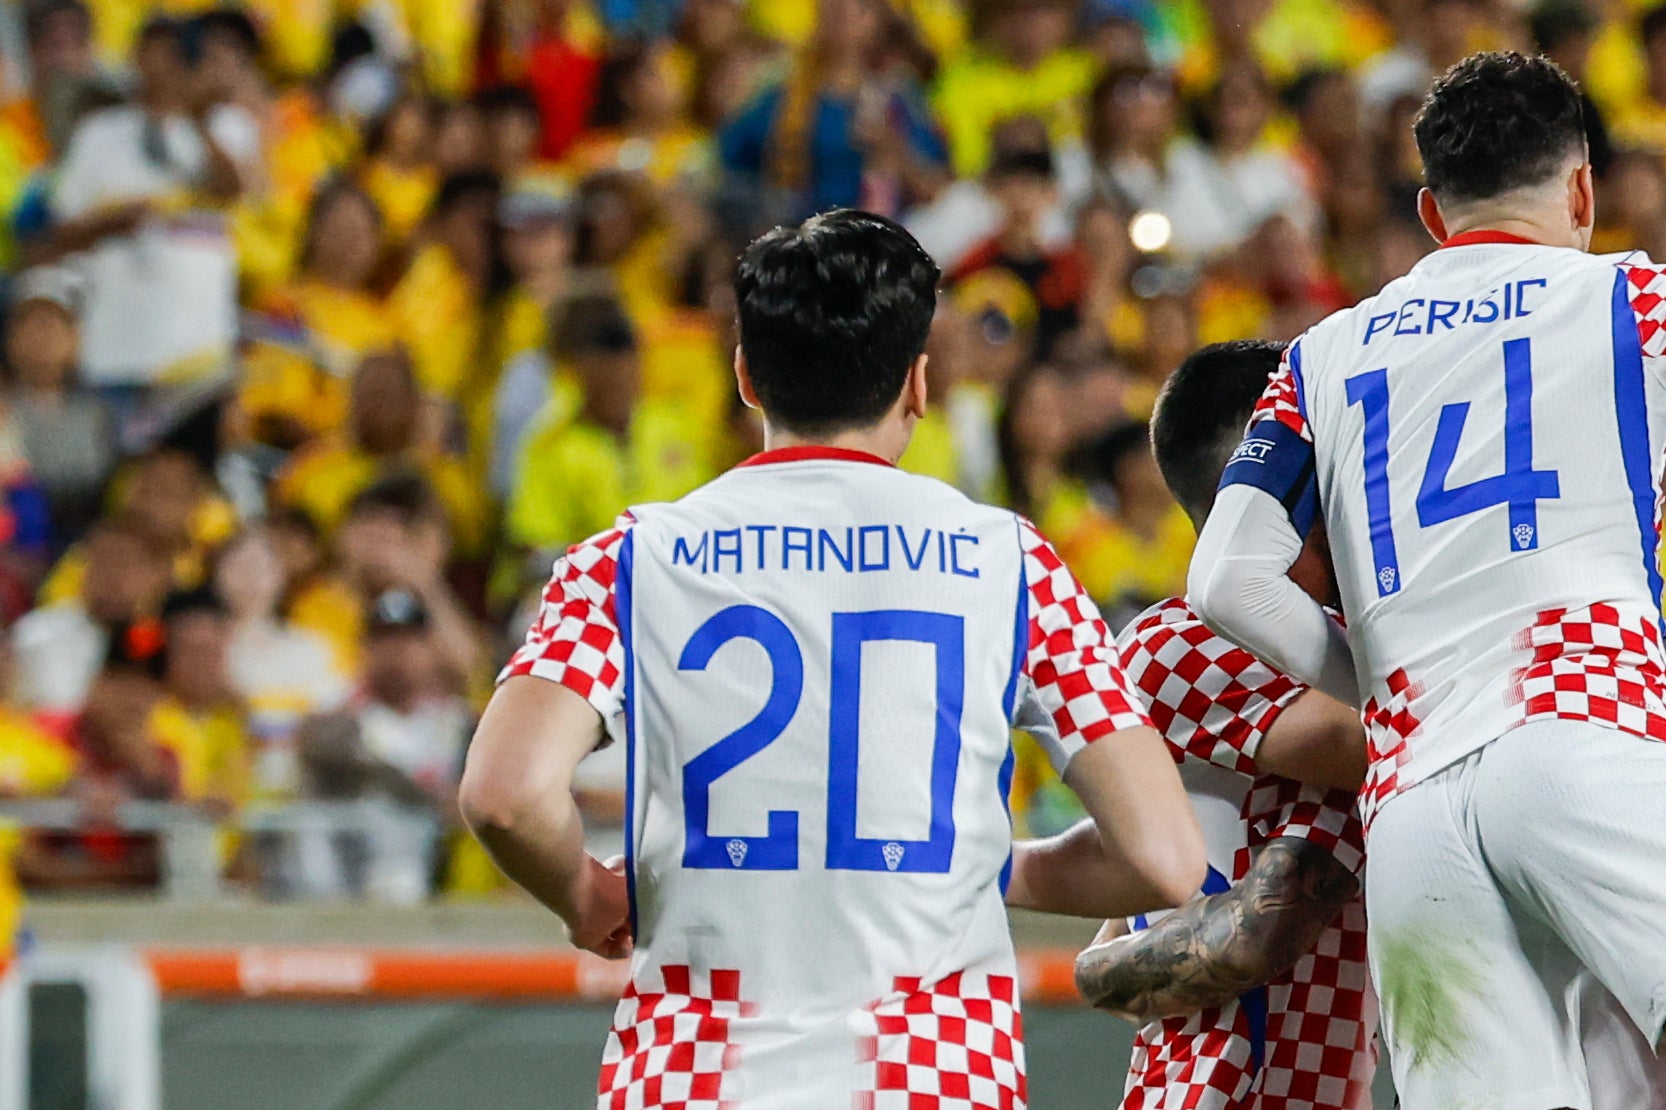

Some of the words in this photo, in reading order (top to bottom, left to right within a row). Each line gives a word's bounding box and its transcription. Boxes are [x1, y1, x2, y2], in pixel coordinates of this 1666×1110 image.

[672, 524, 980, 579] MATANOVIĆ
[1345, 337, 1561, 598] 14
[677, 604, 965, 873] 20
